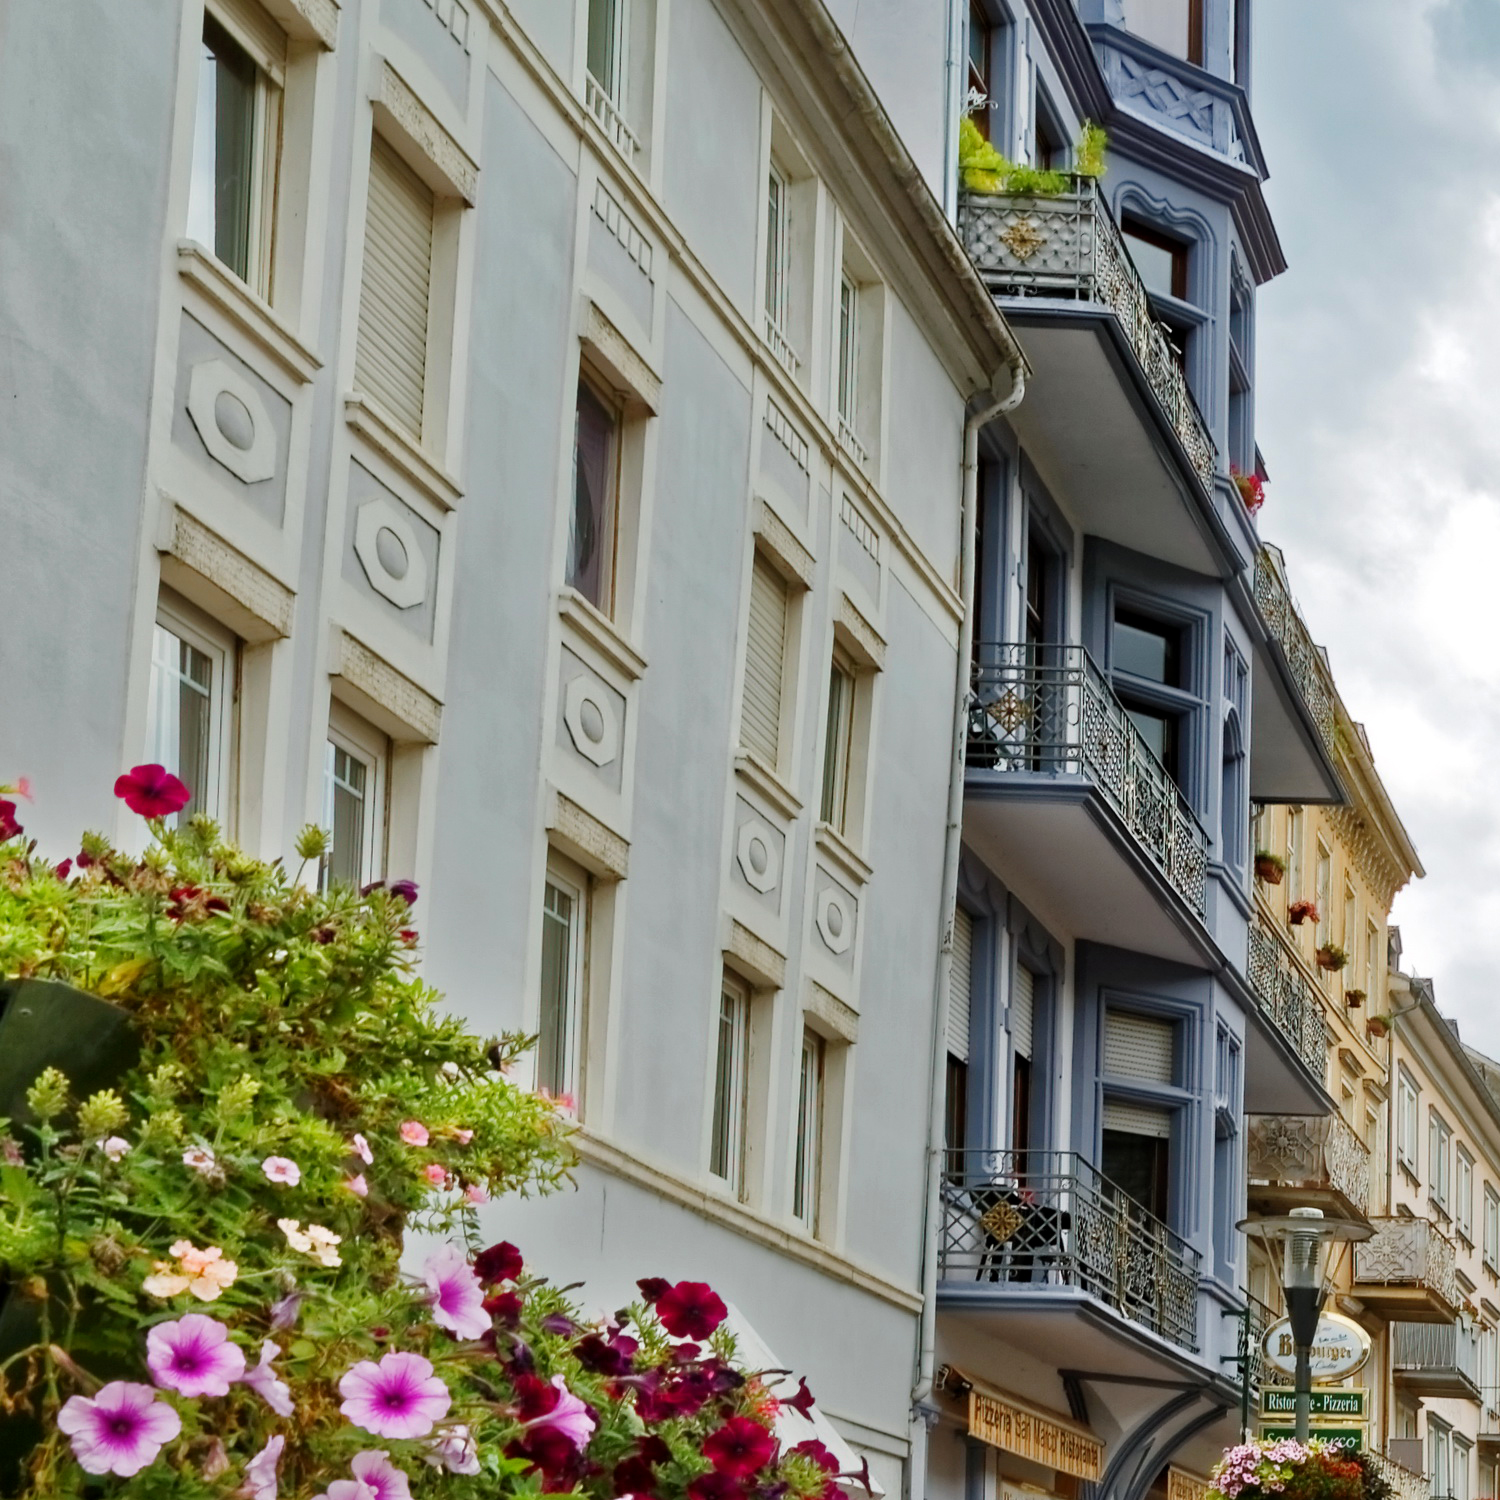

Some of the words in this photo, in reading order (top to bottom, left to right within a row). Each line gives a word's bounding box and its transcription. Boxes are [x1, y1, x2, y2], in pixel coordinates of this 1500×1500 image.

[1268, 1393, 1315, 1411] Ristore
[1323, 1395, 1358, 1412] Pizzeria
[975, 1395, 1011, 1435] Pizzeria
[1015, 1411, 1031, 1441] San
[1060, 1430, 1098, 1467] Ristorante
